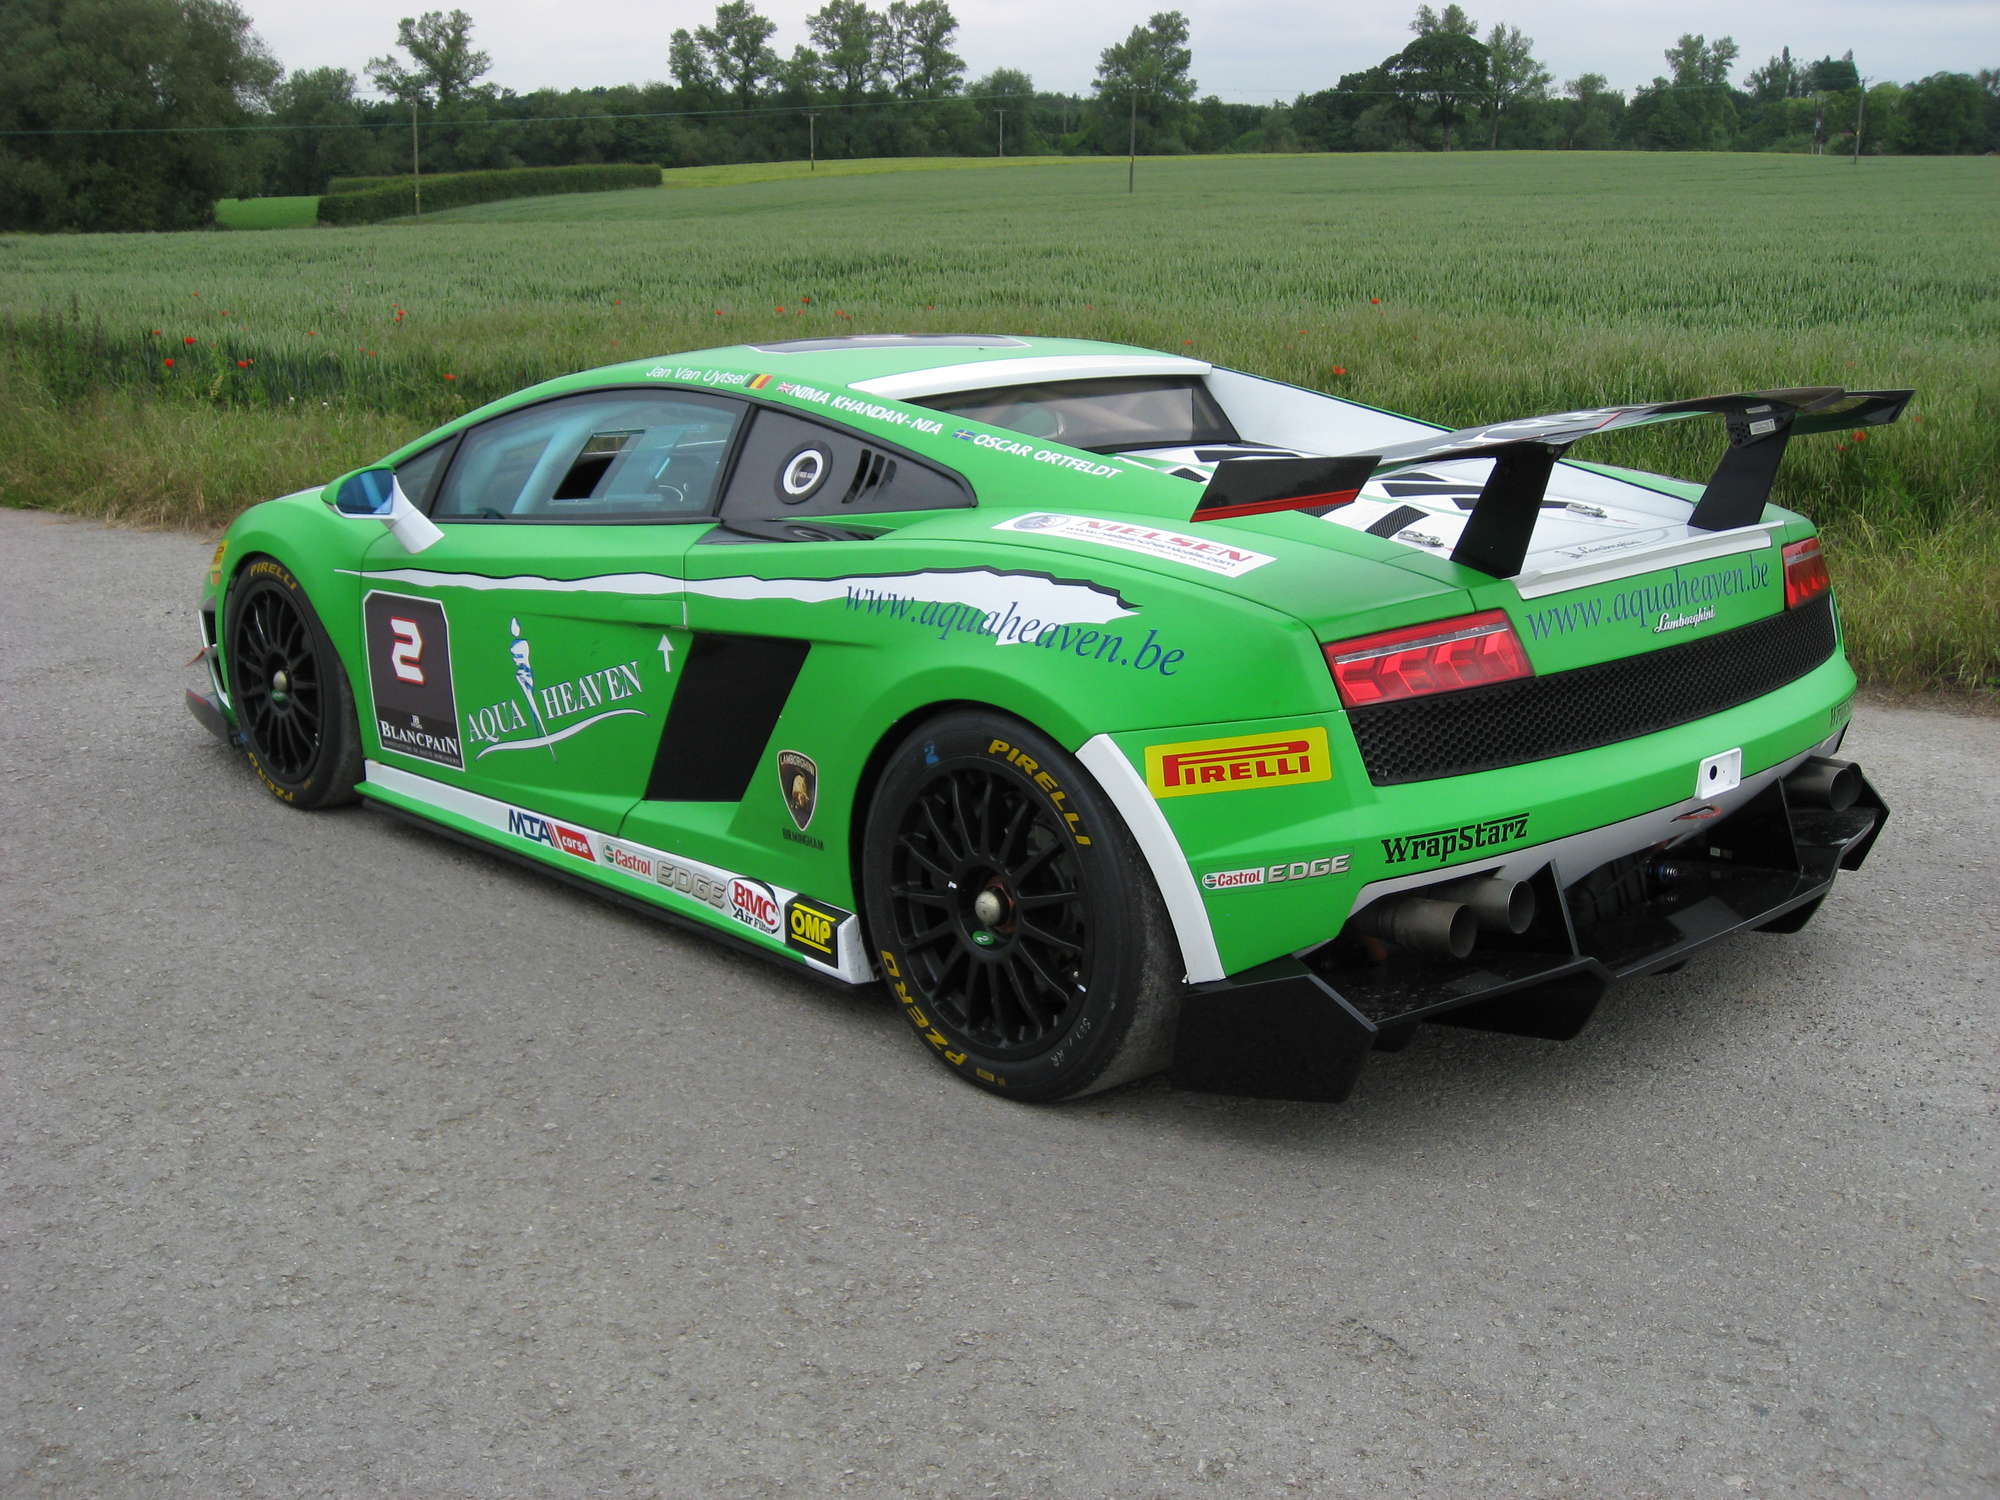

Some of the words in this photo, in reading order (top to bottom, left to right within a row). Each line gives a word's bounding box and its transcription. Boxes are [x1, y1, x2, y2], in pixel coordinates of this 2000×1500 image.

[646, 366, 672, 377] Jan
[674, 367, 702, 380] Van
[703, 368, 751, 386] Uytsel
[789, 384, 832, 405] NIMA
[831, 395, 944, 435] KHANDAN-NIA
[973, 434, 1034, 457] OSCAR
[1033, 450, 1123, 478] ORTFELDT
[1077, 521, 1253, 562] NIELSEN
[1525, 550, 1769, 641] www.aquaheaven.be
[843, 585, 1186, 677] www.aquaheaven.be
[1652, 604, 1715, 633] Lamborghini
[389, 616, 426, 685] 2
[467, 699, 528, 743] AQUA
[540, 661, 644, 719] HEAVEN
[1162, 740, 1311, 787] PIRELLI
[988, 739, 1092, 846] PIRELLI
[508, 809, 554, 848] MTA
[561, 836, 590, 853] corse
[1381, 812, 1531, 864] WrapStarz
[615, 849, 652, 876] Castrol
[656, 860, 727, 910] EDGE
[1217, 870, 1262, 887] Castrol
[1266, 854, 1351, 883] EDGE
[733, 881, 776, 925] BMC
[733, 907, 754, 925] Air
[791, 909, 832, 945] OMP
